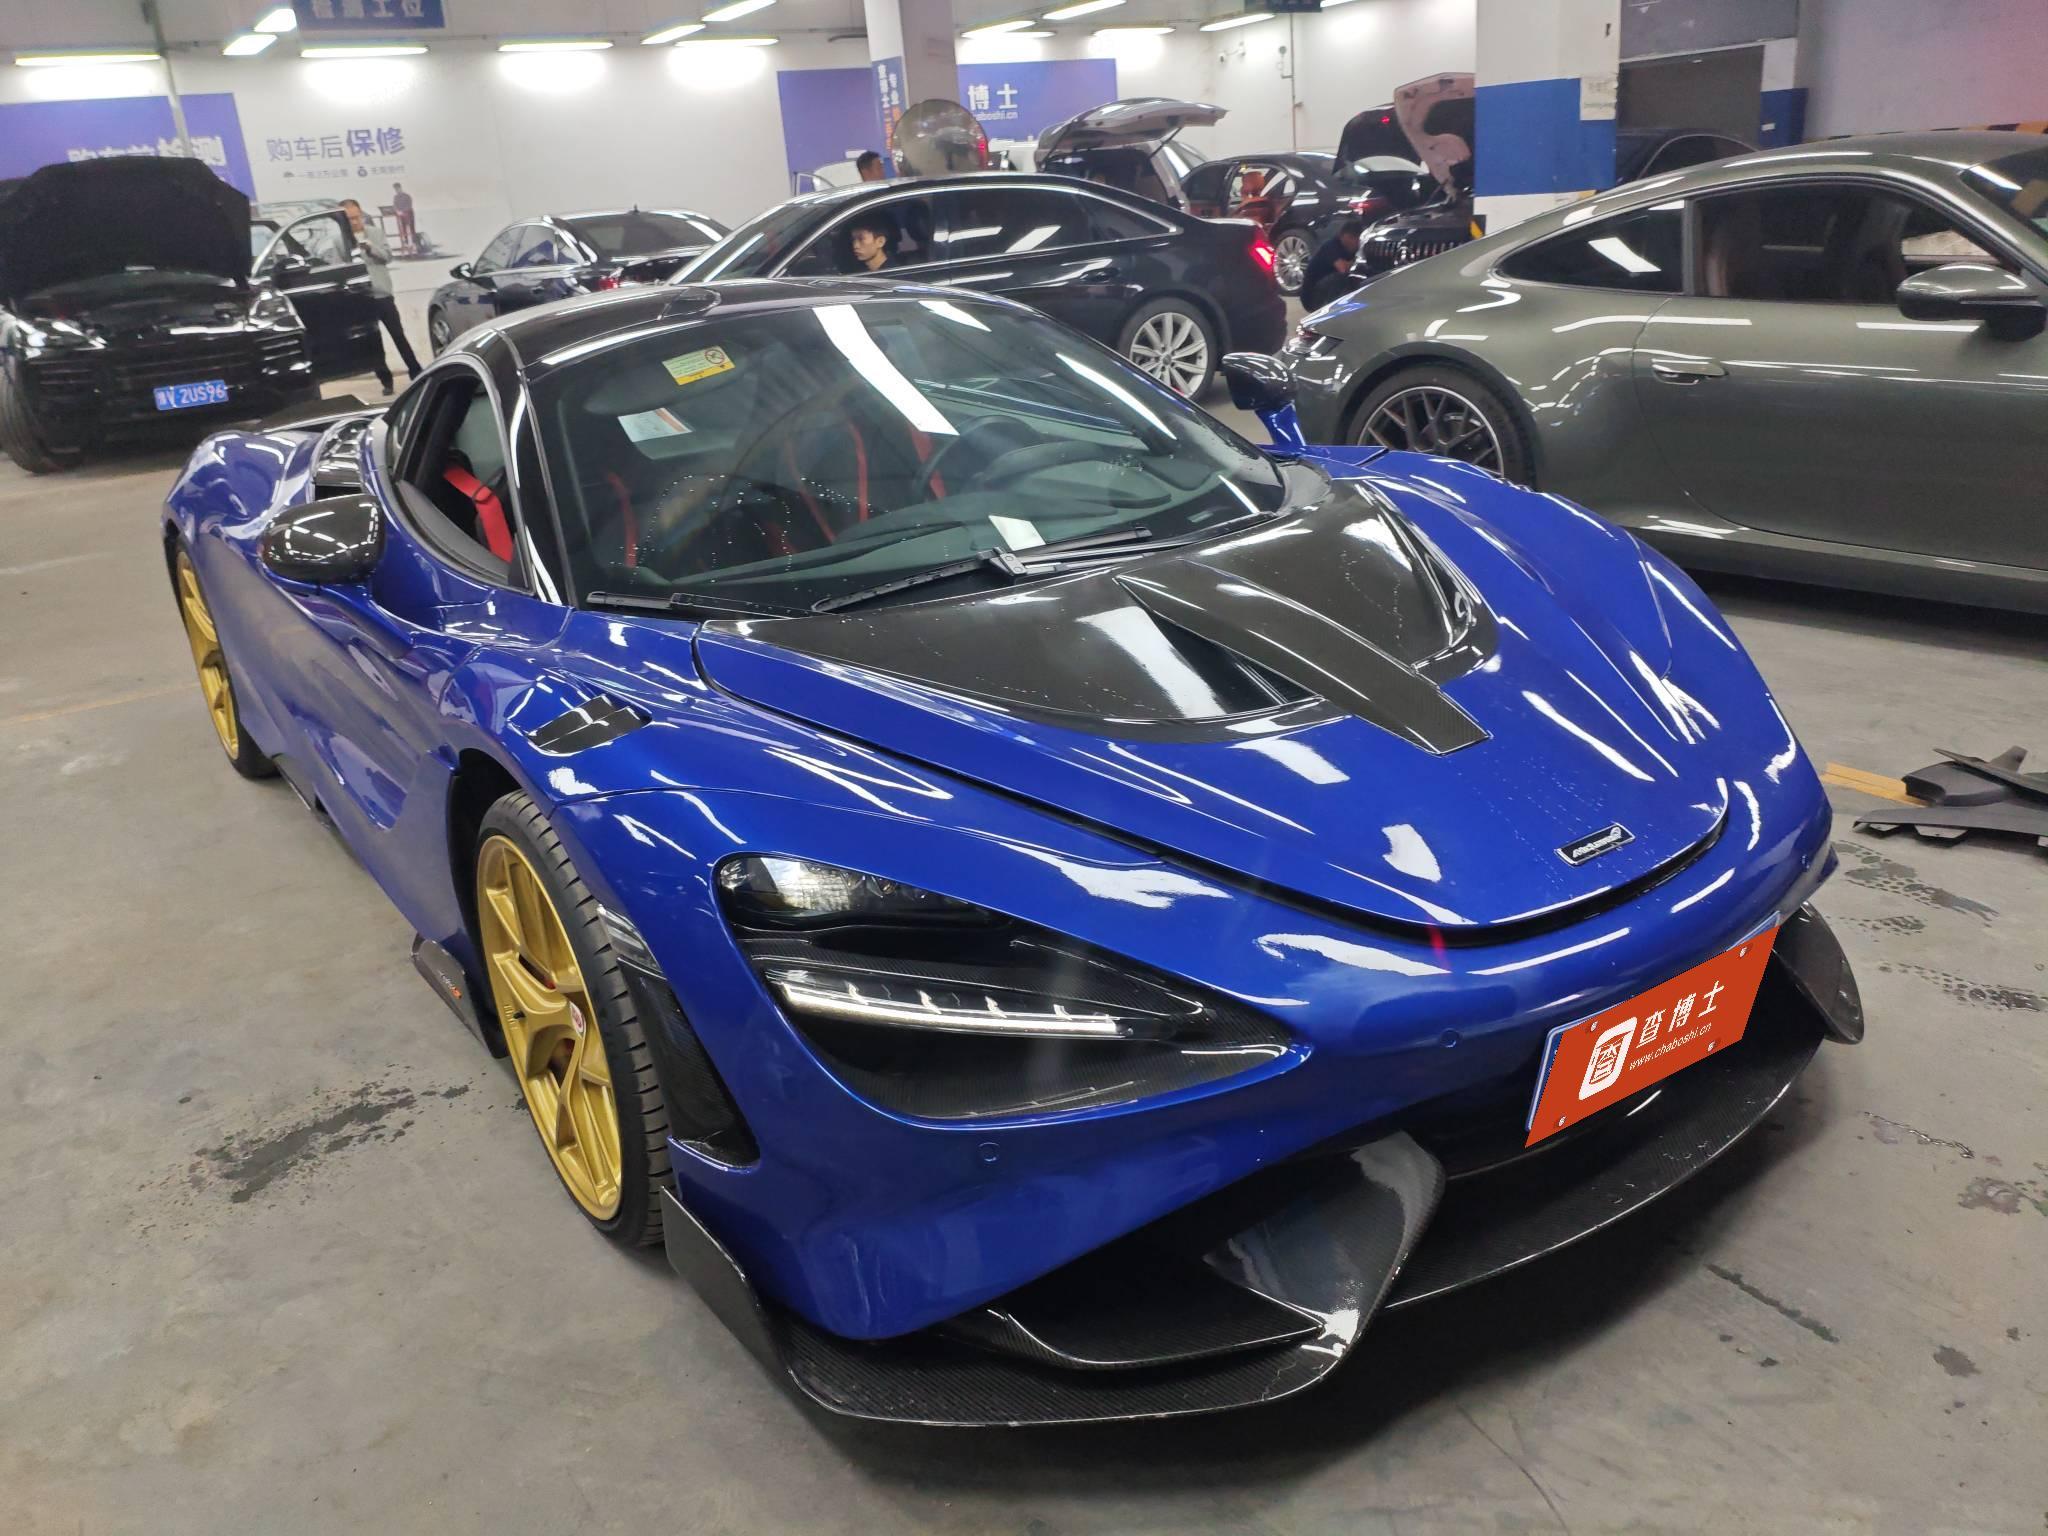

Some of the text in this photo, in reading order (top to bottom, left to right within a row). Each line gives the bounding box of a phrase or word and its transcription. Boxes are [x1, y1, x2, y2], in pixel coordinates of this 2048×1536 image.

[266, 127, 405, 162] 购车后保修
